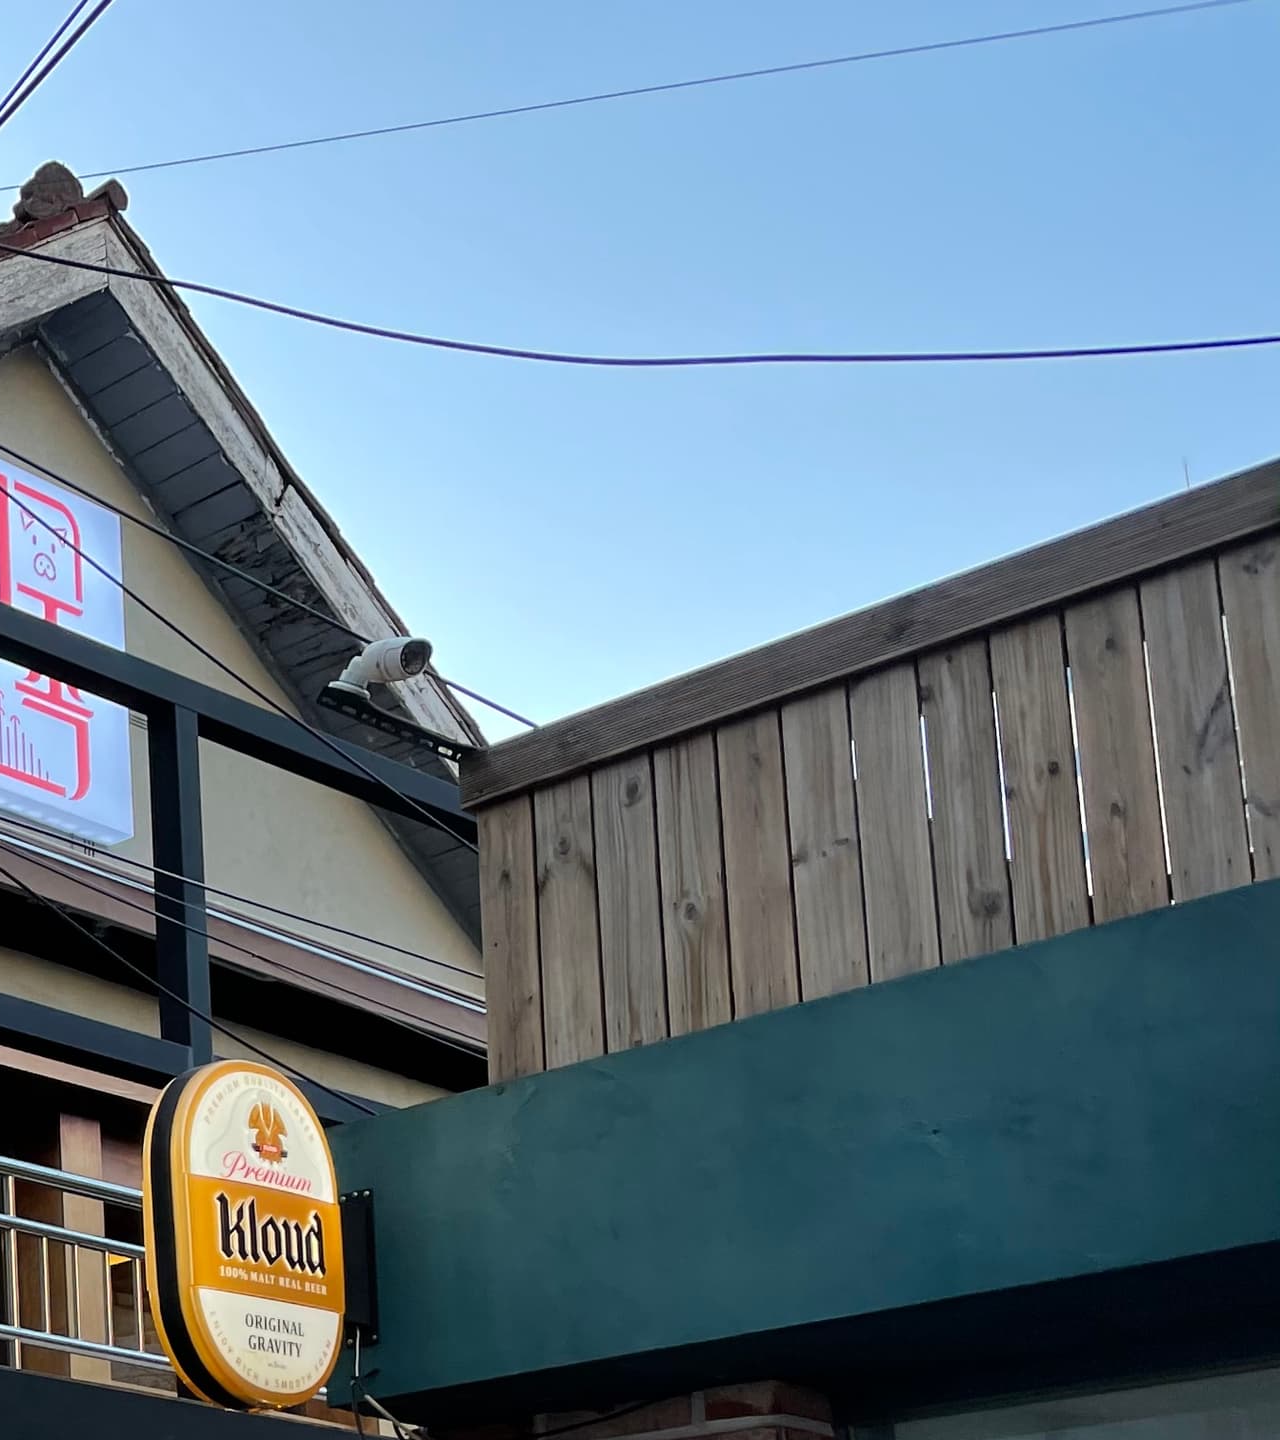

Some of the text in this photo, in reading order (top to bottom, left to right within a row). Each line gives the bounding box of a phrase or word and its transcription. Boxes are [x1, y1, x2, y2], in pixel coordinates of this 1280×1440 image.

[221, 1149, 312, 1194] Premium
[215, 1191, 328, 1278] Kloud
[218, 1264, 328, 1296] 100% MALT REAL BEER
[244, 1312, 305, 1337] ORIGINAL
[248, 1335, 303, 1358] GRAVITY
